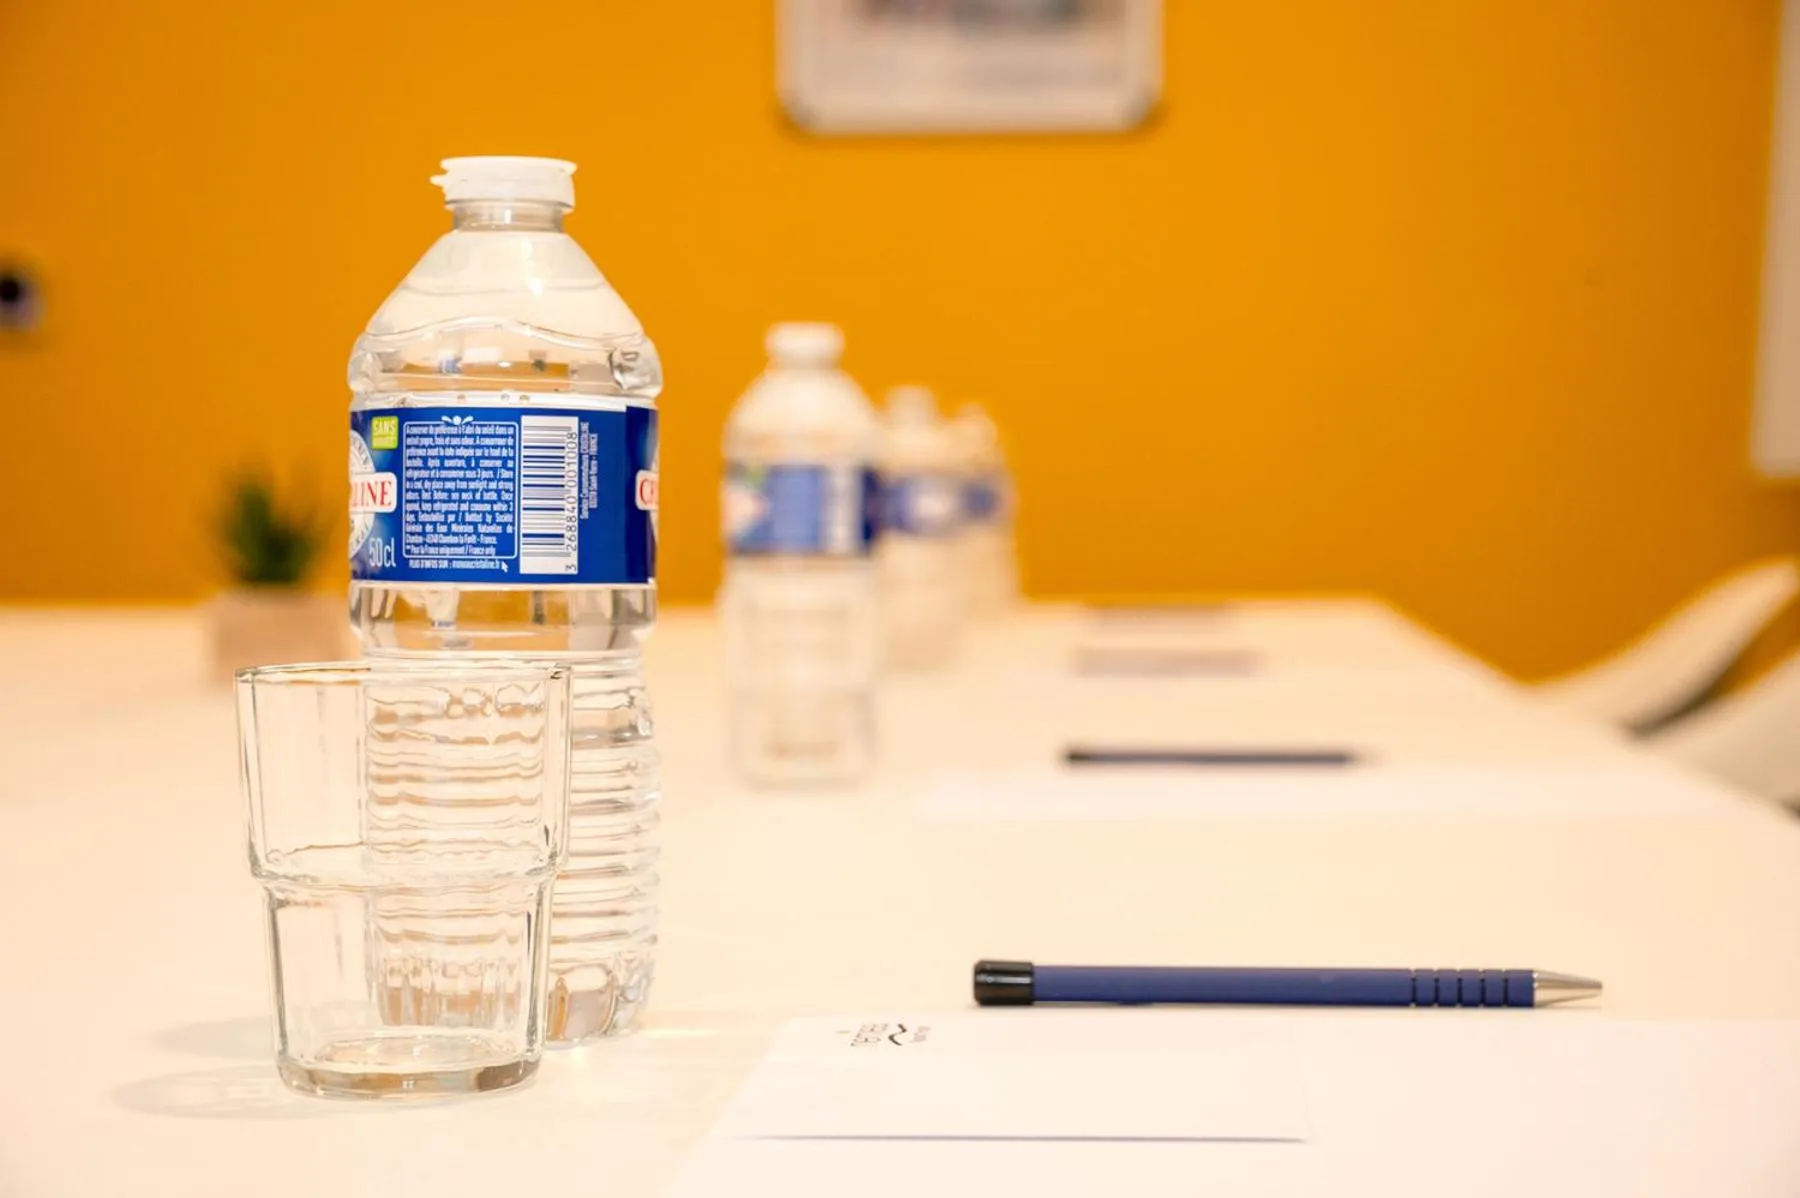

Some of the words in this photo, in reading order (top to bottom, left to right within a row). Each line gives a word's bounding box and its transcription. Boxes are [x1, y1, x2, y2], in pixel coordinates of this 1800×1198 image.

[566, 432, 578, 488] 001008
[566, 495, 577, 552] 268840
[368, 537, 397, 568] 50cl
[565, 564, 577, 572] 3
